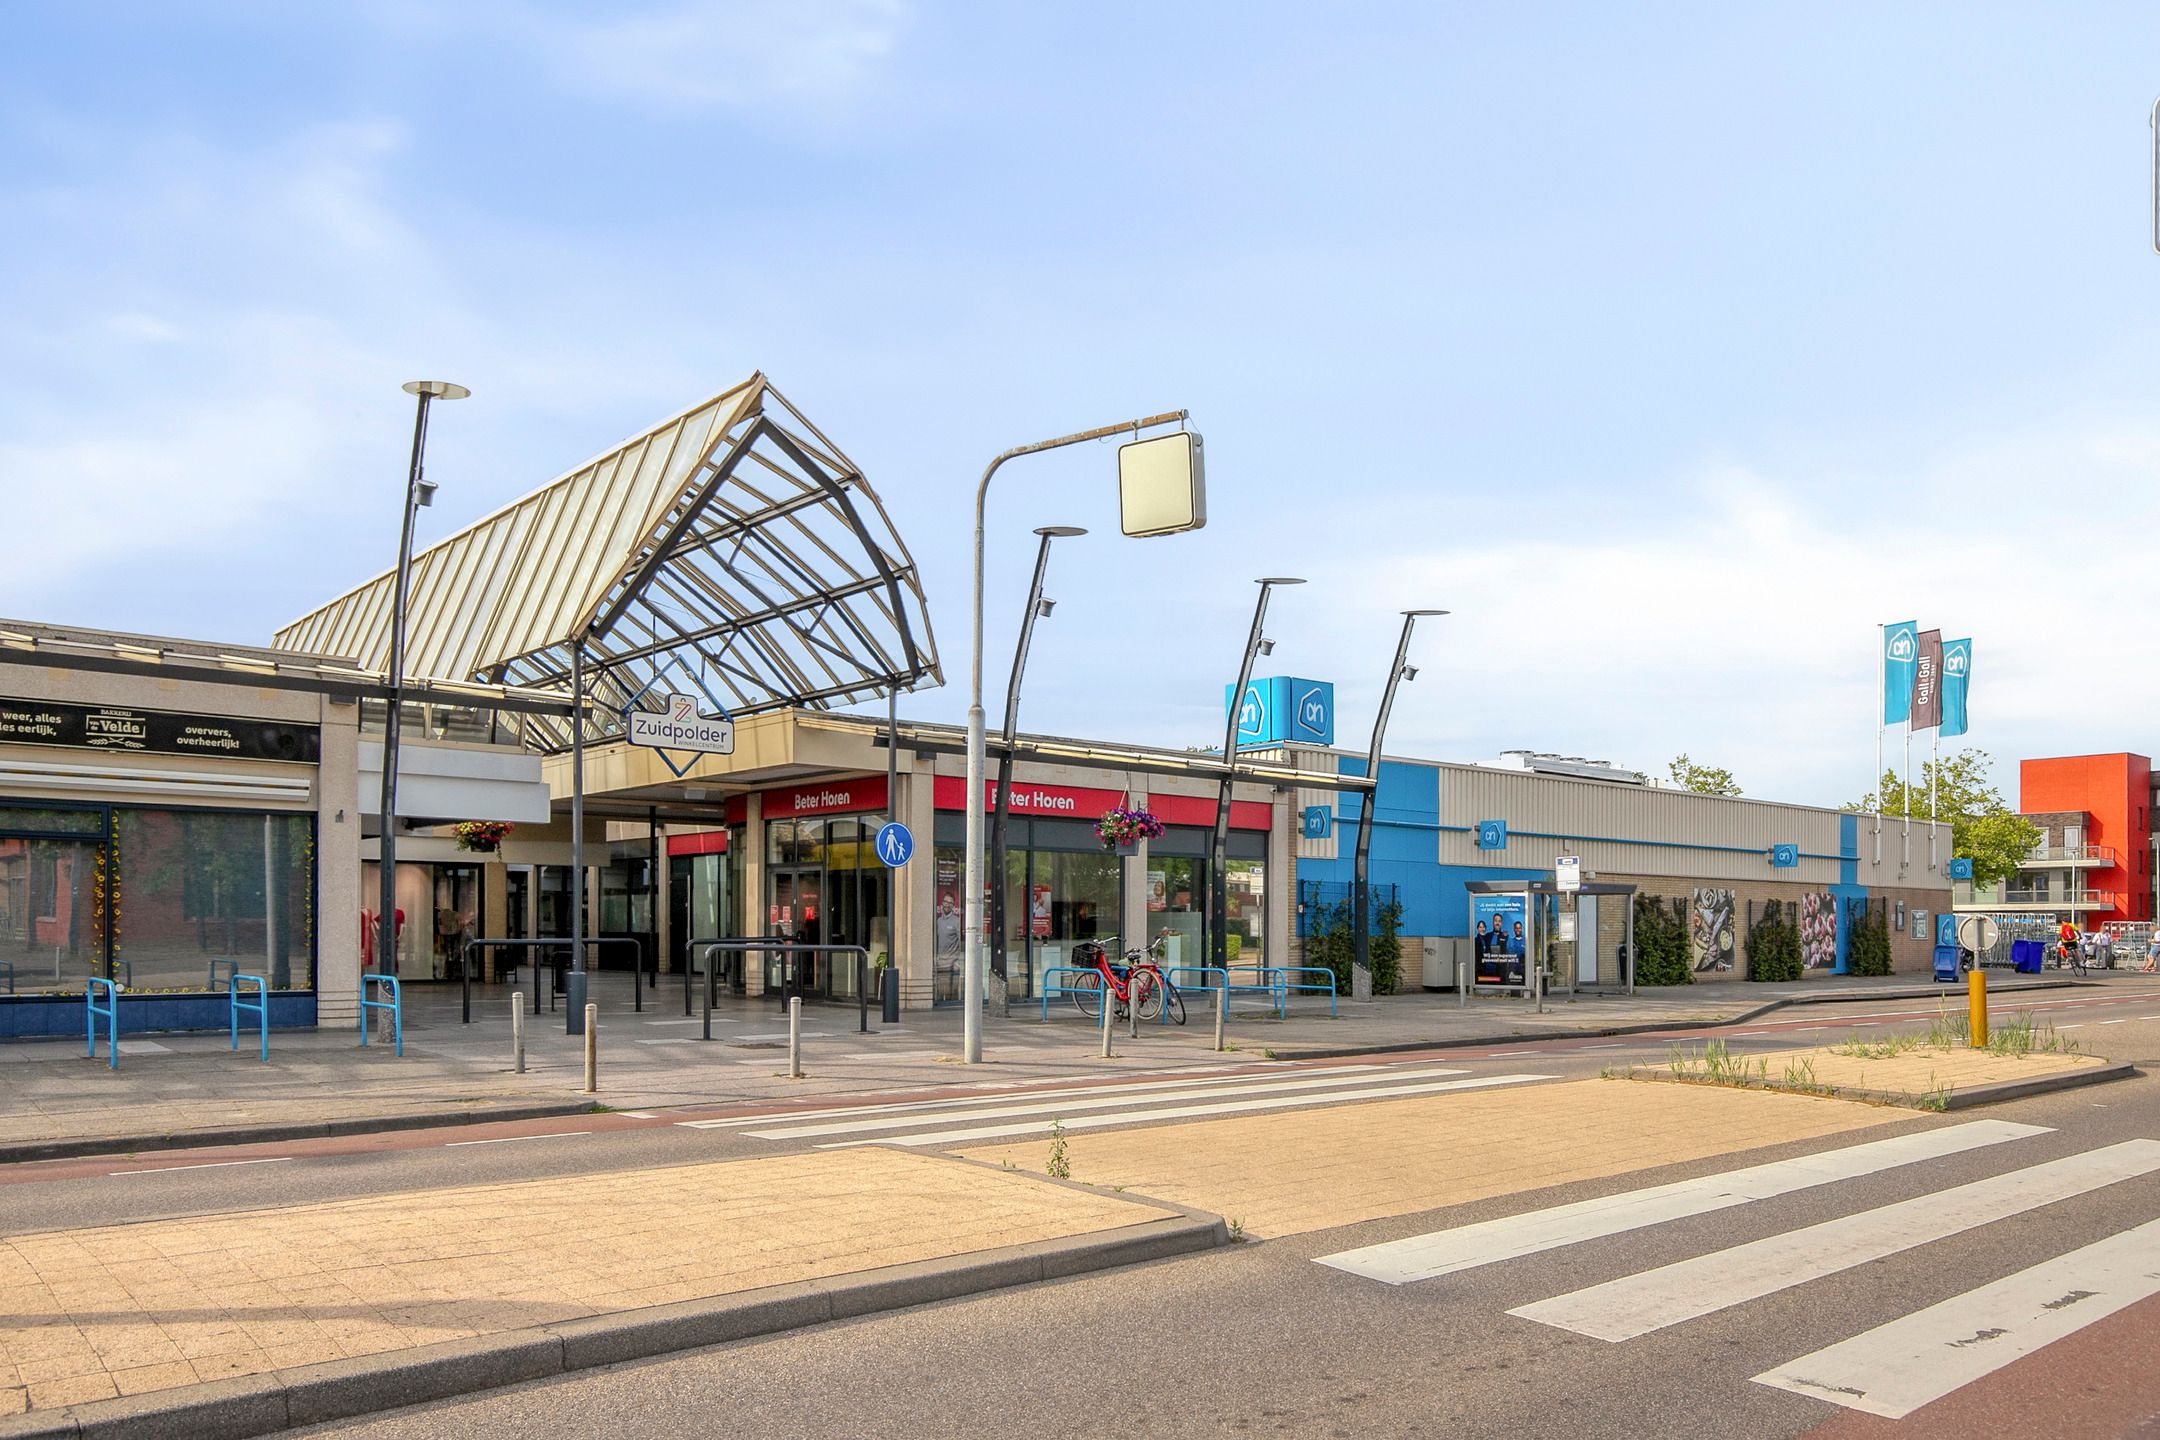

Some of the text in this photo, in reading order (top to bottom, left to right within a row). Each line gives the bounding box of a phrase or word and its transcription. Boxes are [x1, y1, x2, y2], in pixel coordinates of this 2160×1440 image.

[2, 712, 62, 724] weer, alles
[17, 724, 57, 737] eerlijk,
[99, 719, 140, 734] Velde
[635, 719, 727, 745] Zuidpolder
[176, 737, 240, 750] overheerlijk!
[677, 740, 725, 750] WINKELCENTRUM
[794, 790, 850, 810] Beter Horen
[1033, 791, 1075, 810] Horen
